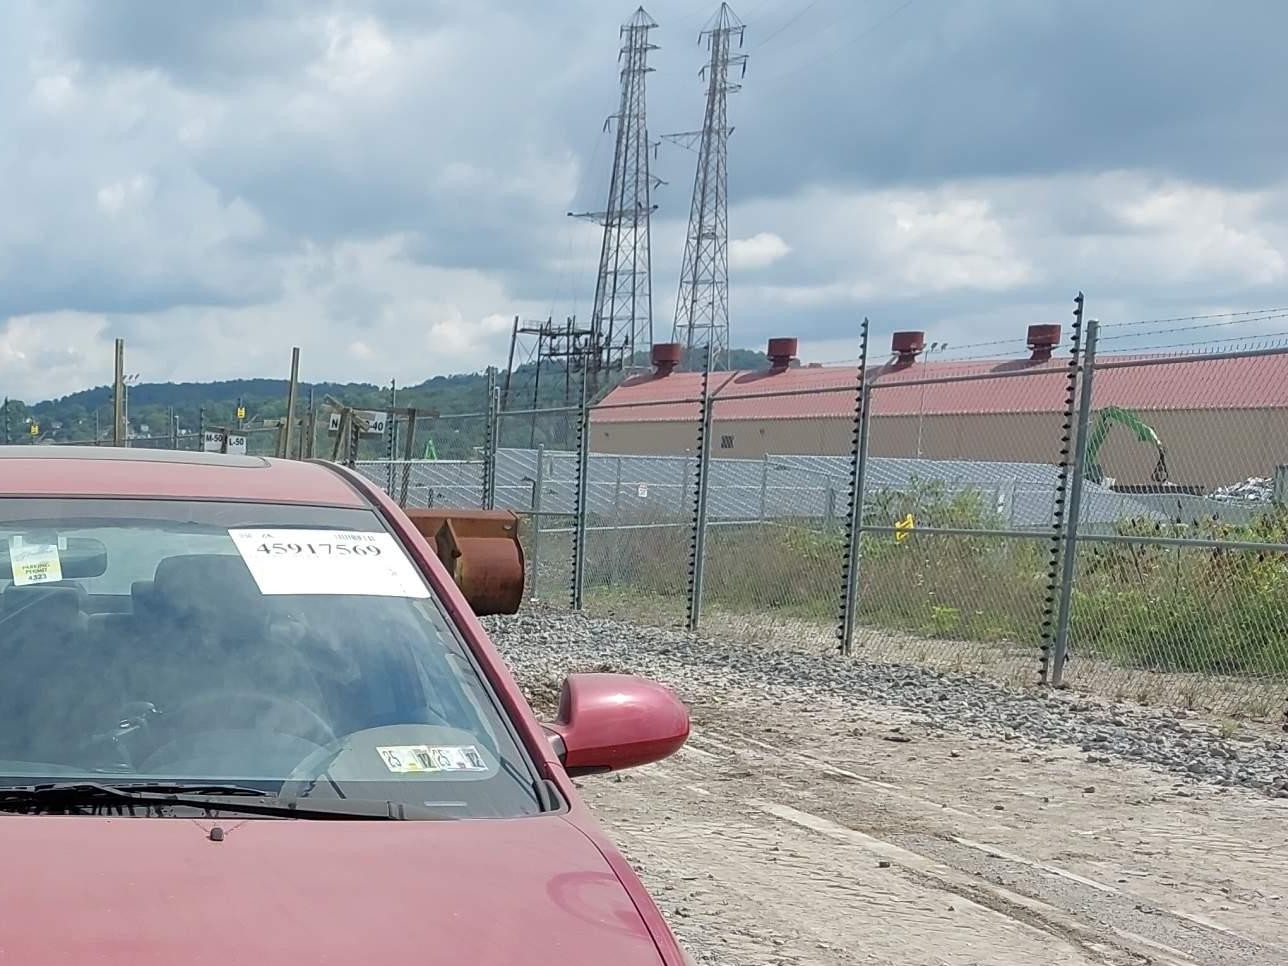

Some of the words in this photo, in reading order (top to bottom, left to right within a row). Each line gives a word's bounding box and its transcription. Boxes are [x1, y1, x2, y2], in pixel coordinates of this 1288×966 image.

[205, 434, 223, 442] M-50
[229, 437, 244, 446] L-50
[256, 543, 382, 556] 45917569
[383, 750, 402, 768] 25
